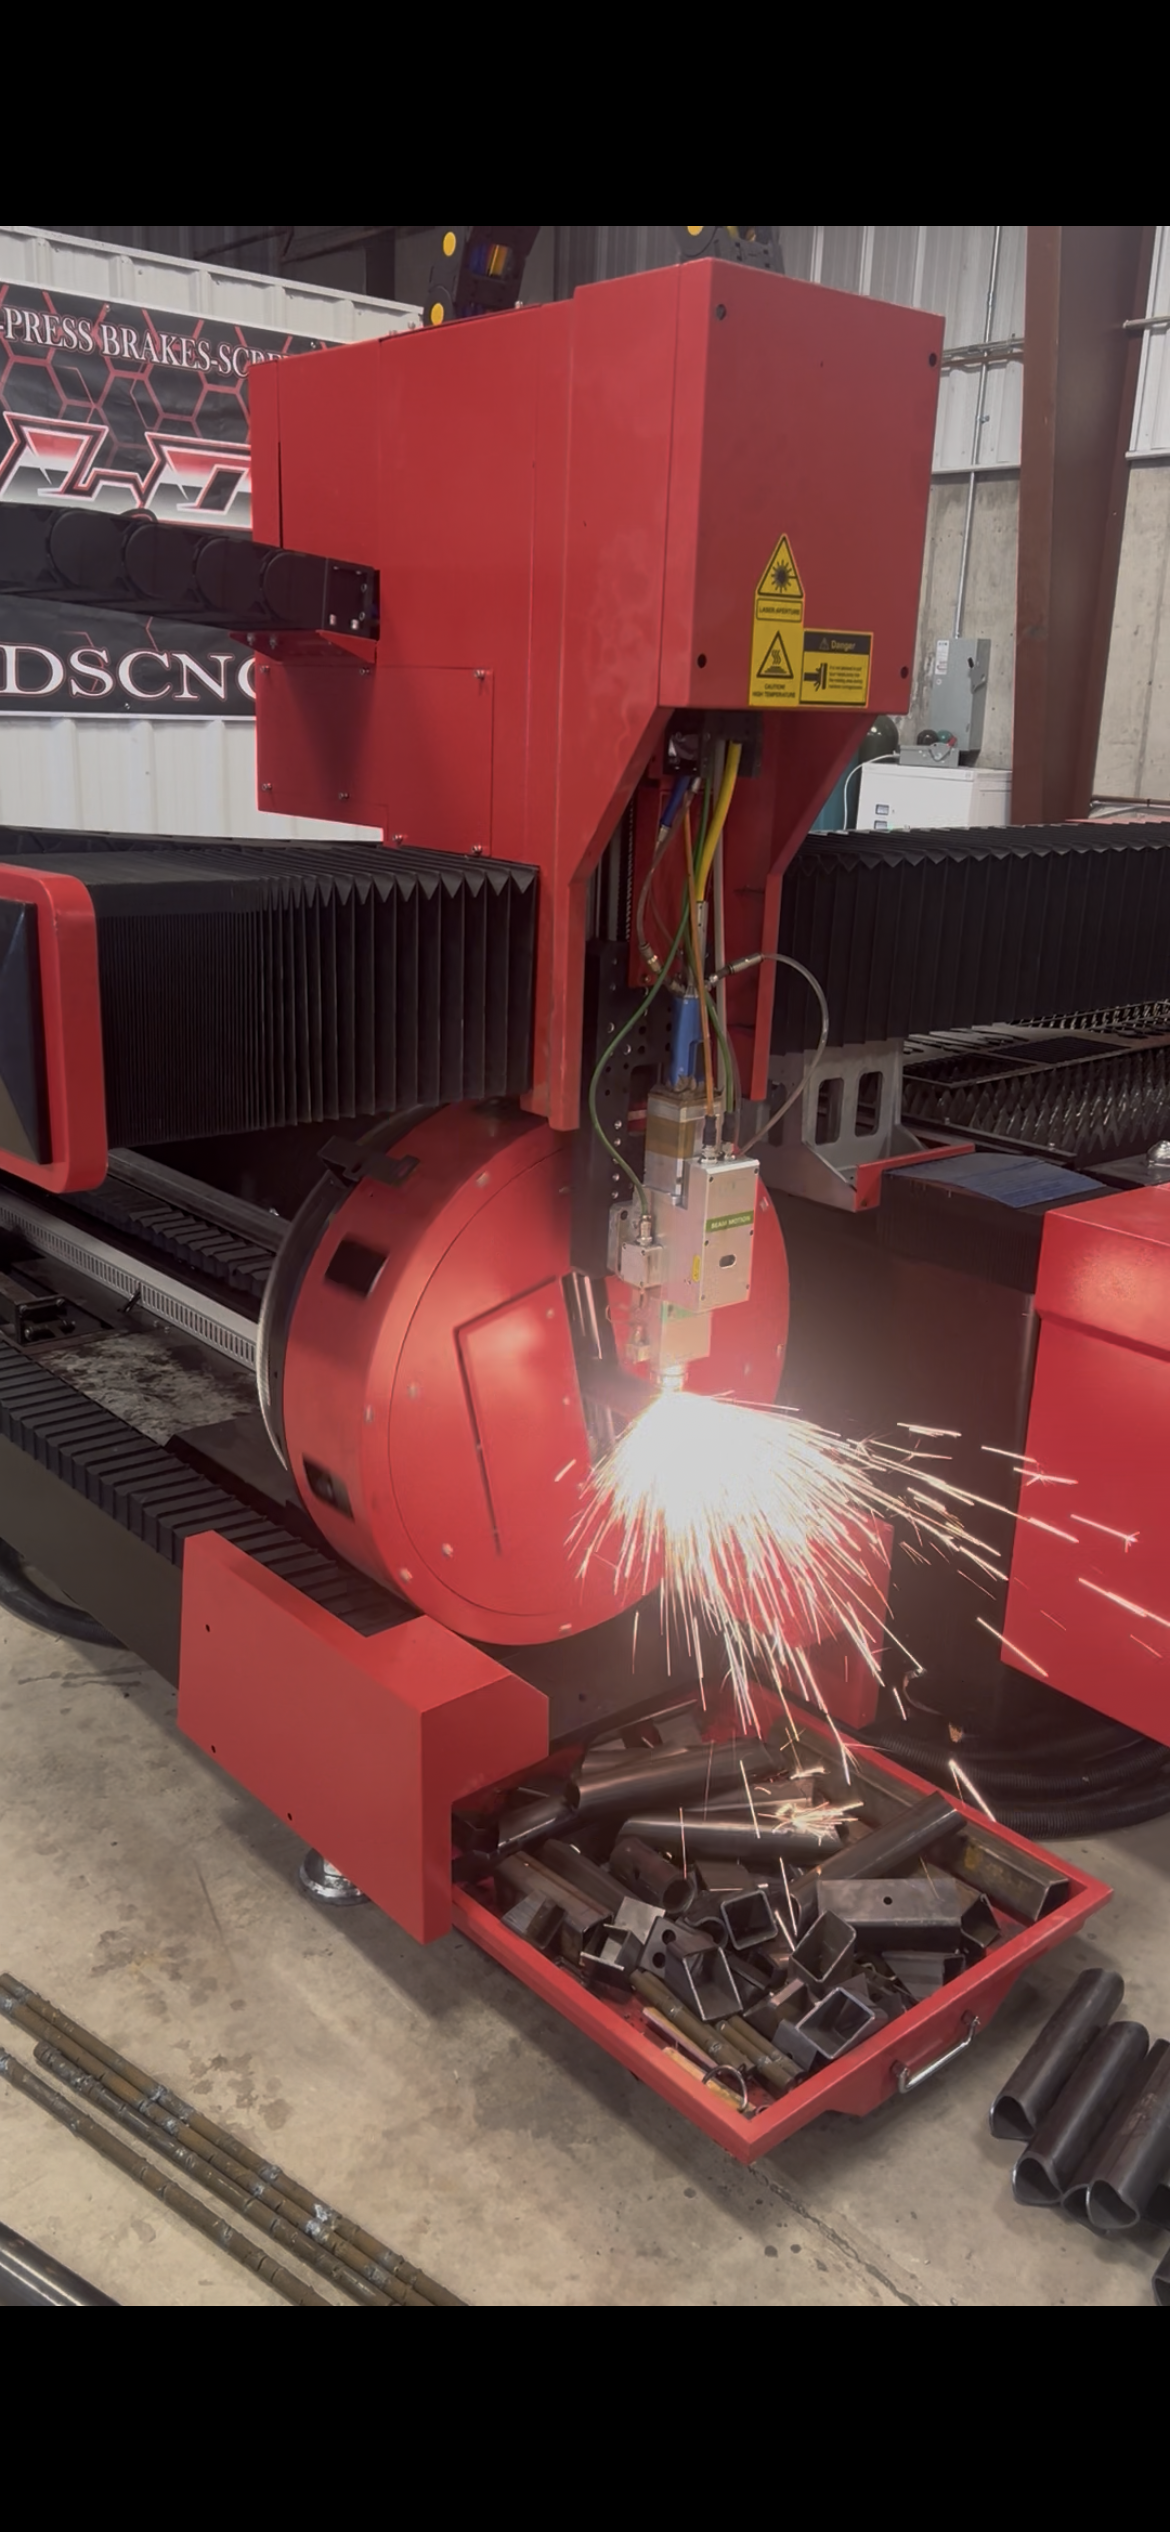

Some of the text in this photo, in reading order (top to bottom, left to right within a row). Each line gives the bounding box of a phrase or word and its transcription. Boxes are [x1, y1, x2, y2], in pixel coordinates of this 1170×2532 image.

[101, 324, 289, 378] BRAKES-SC
[758, 606, 800, 616] LASER APERTURE
[831, 639, 856, 652] Danger
[765, 691, 796, 699] TEMPERATURE
